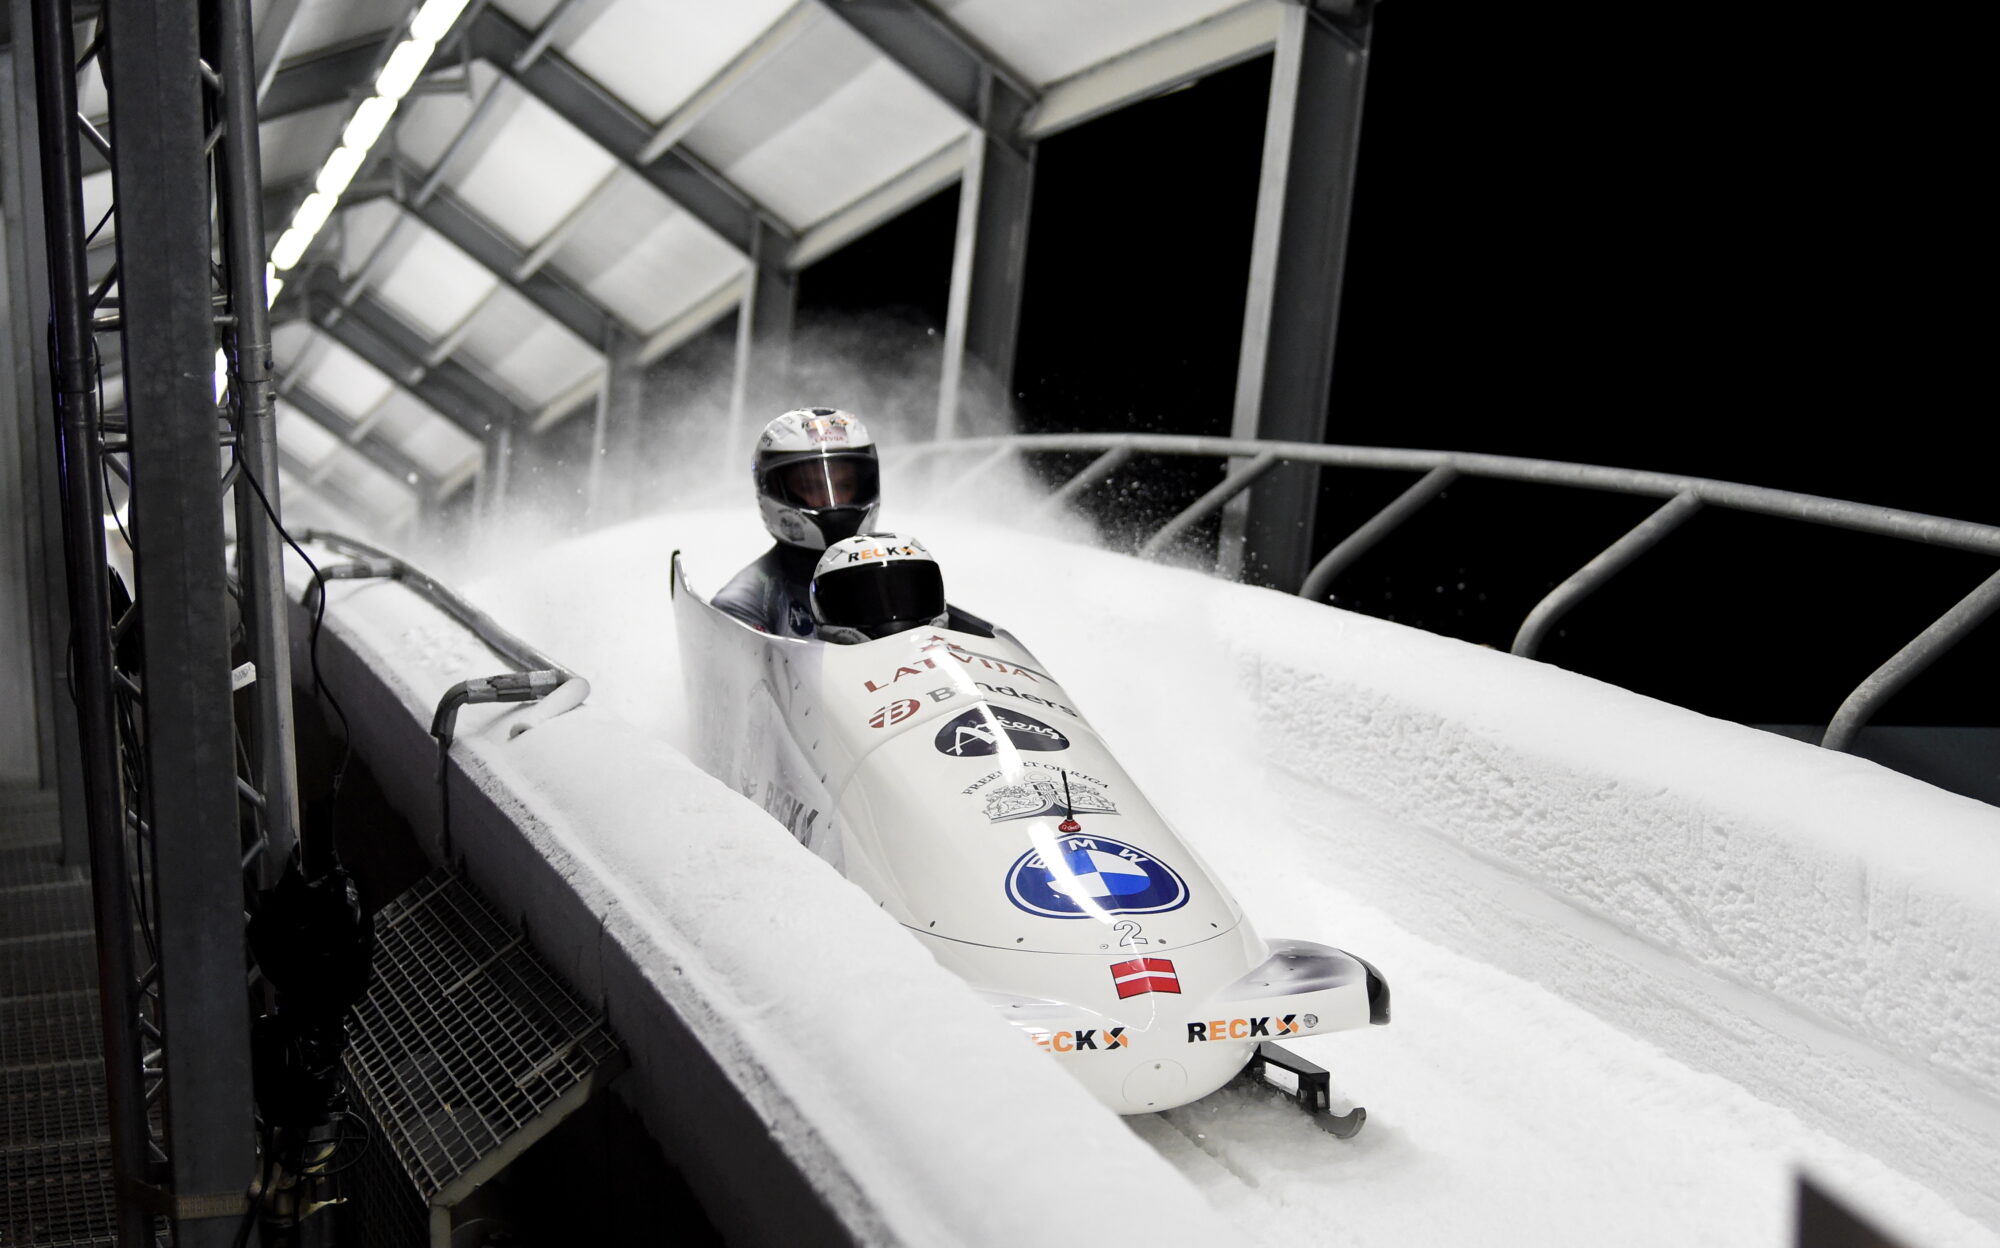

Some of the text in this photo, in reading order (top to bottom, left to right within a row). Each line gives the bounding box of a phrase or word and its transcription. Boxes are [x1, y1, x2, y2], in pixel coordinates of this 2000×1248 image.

[848, 546, 900, 563] RECK
[863, 651, 1041, 693] LATVIJA
[926, 681, 1078, 718] Bnders
[961, 761, 1039, 795] FREERT
[1069, 770, 1109, 789] RIGA
[1025, 839, 1149, 869] BMW
[1113, 920, 1148, 947] 2
[1187, 1016, 1270, 1044] RECK
